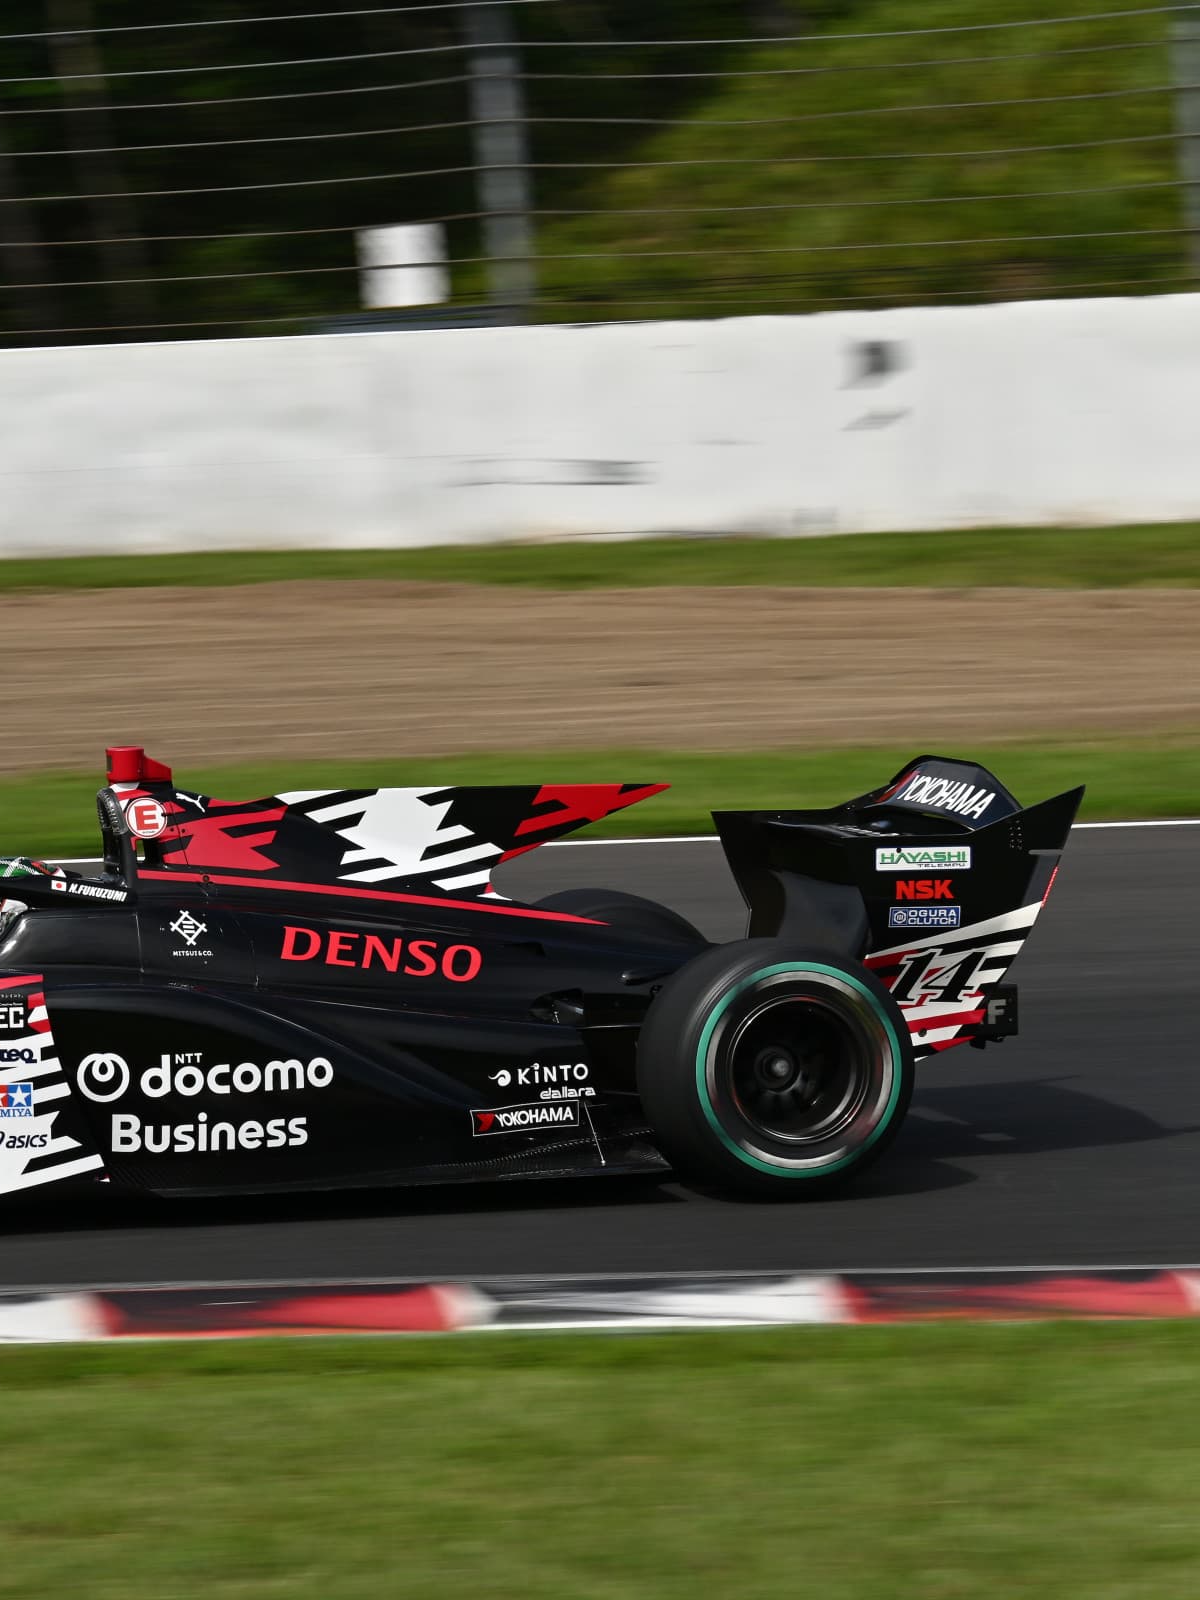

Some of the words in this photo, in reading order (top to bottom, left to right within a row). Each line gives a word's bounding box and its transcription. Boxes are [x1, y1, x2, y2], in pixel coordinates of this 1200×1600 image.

[897, 775, 996, 819] YOKOHAMA
[134, 804, 159, 831] E
[880, 851, 967, 864] HAYASHI
[68, 882, 128, 902] N.FUKUZUMI
[895, 879, 955, 900] NSK
[907, 917, 957, 925] CLUTCH
[908, 909, 956, 917] OGURA
[280, 925, 482, 982] DENSO
[891, 950, 986, 1003] 14
[175, 1053, 203, 1064] NTT
[140, 1054, 334, 1098] docomo
[539, 1086, 596, 1100] dallara
[494, 1106, 574, 1127] YOKOHAMA
[5, 1134, 48, 1149] asics
[111, 1112, 308, 1153] Business
